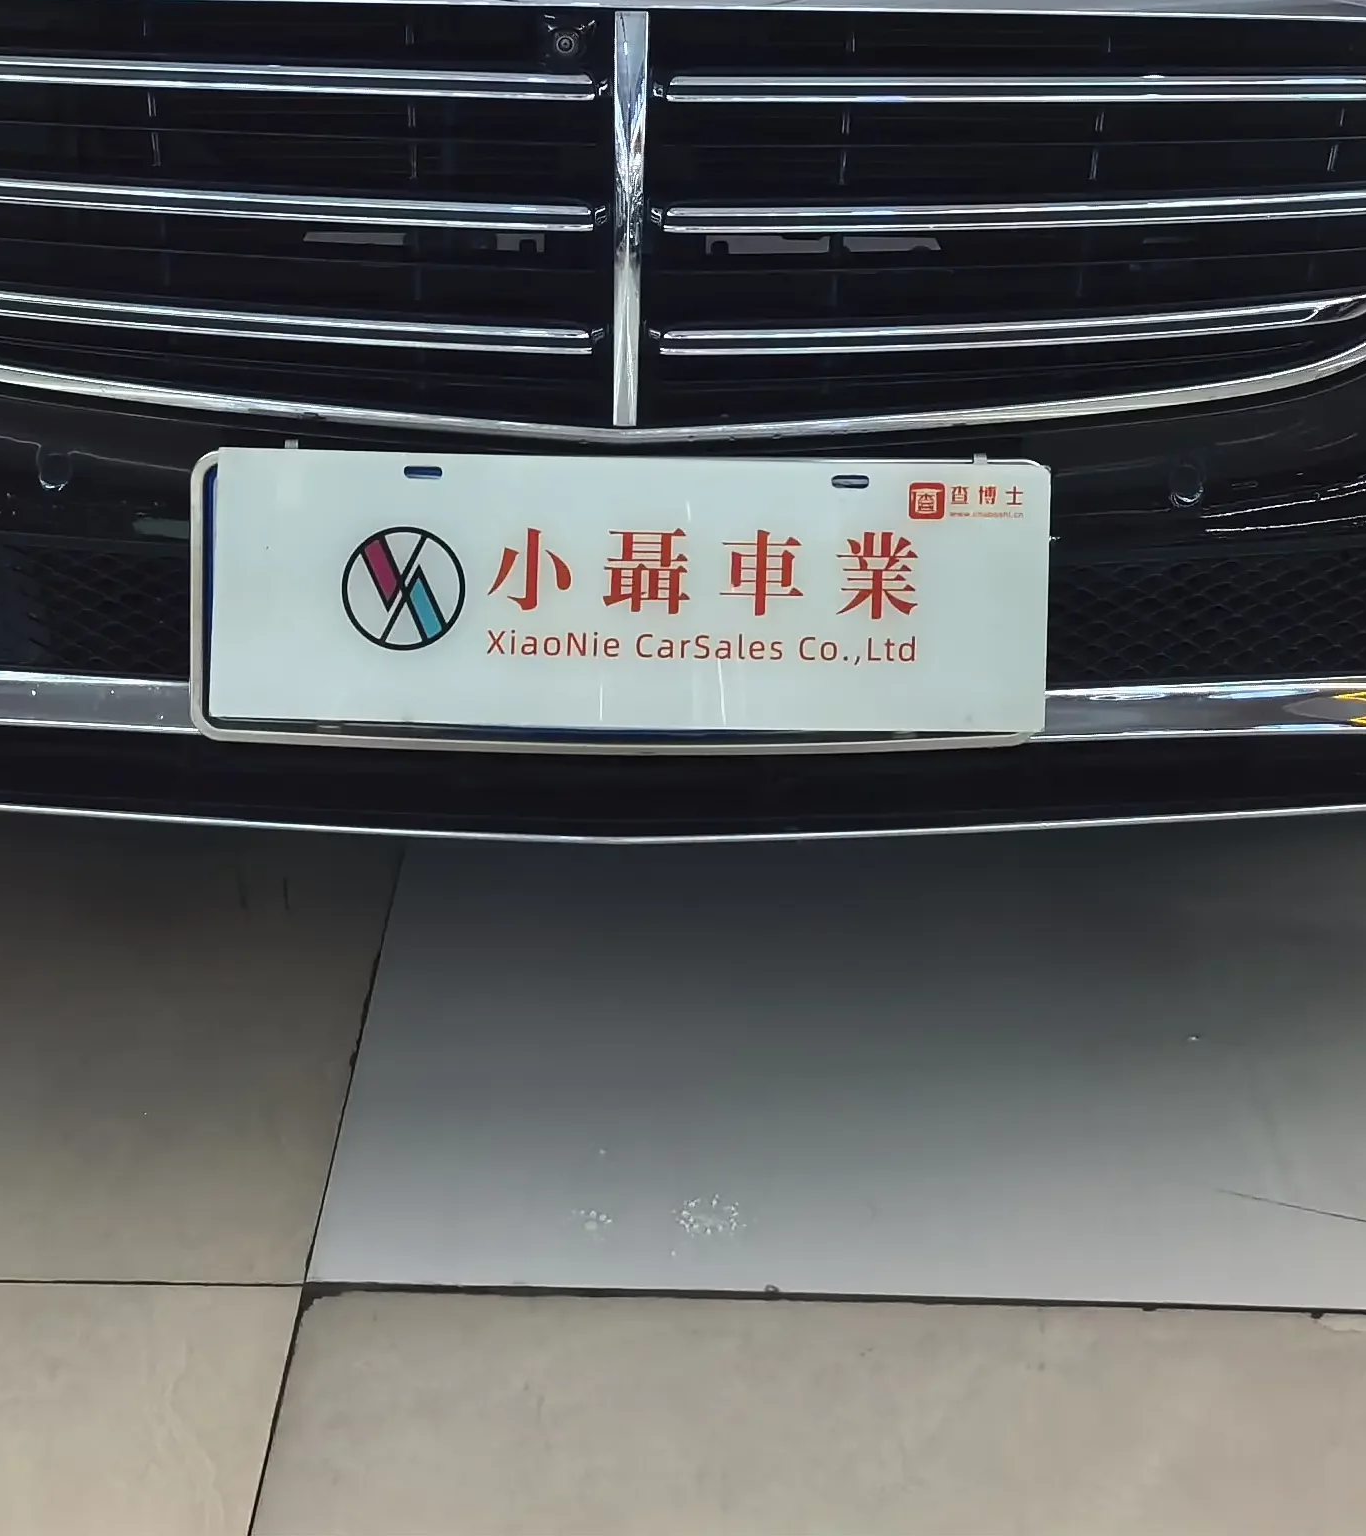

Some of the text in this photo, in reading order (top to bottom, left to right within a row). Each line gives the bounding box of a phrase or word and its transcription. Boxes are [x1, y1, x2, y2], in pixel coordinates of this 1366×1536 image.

[951, 486, 1024, 505] 查博士
[487, 528, 919, 619] 小聶車業
[486, 630, 916, 666] XiaoNie CarSales Co.,Ltd
